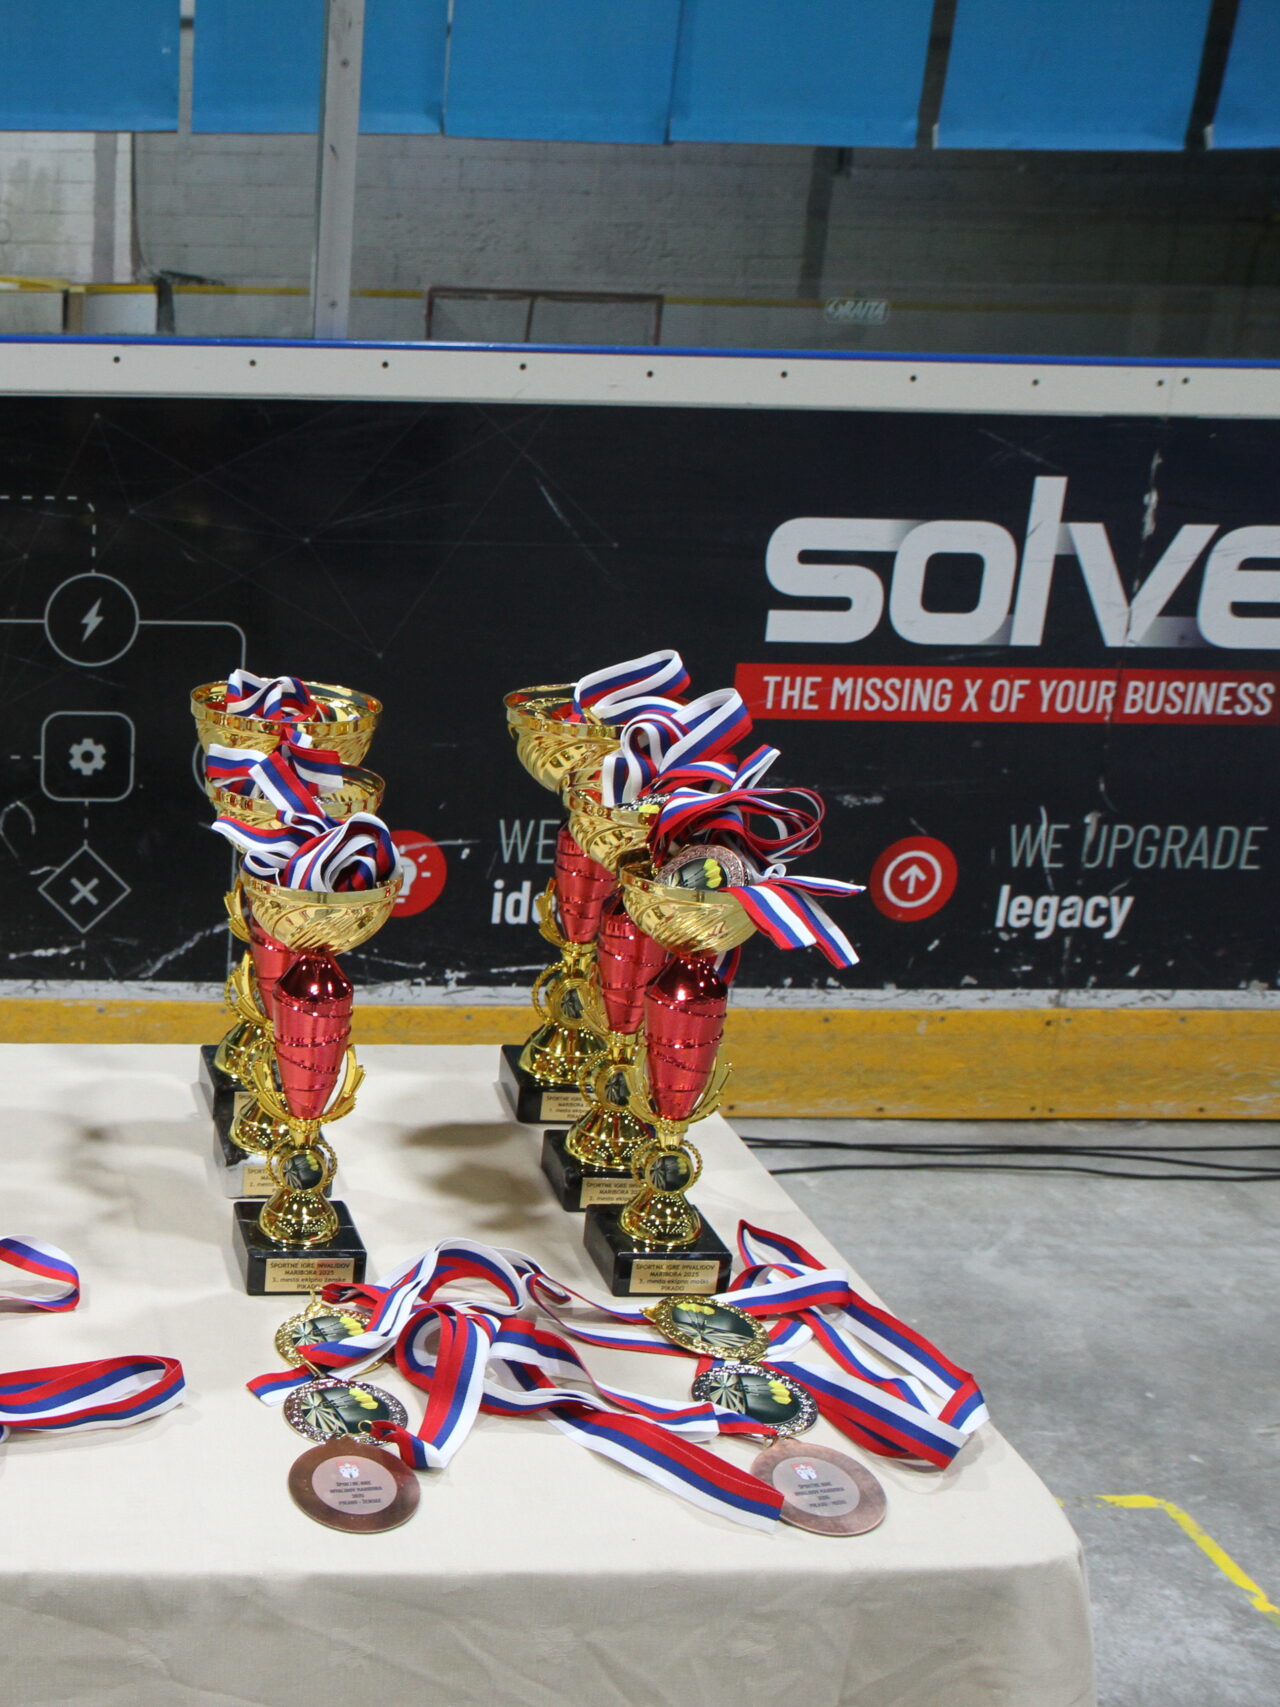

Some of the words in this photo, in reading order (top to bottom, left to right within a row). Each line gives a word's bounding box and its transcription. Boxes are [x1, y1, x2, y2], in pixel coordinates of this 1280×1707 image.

[763, 676, 822, 710] THE
[829, 677, 953, 712] MISSING
[960, 679, 983, 713] X
[989, 680, 1031, 713] OF
[1039, 680, 1117, 714] YOUR
[1123, 681, 1275, 716] BUSINESS
[499, 819, 562, 864] WE
[1010, 823, 1070, 868] WE
[1081, 824, 1268, 870] UPGRADE
[994, 885, 1135, 940] legacy
